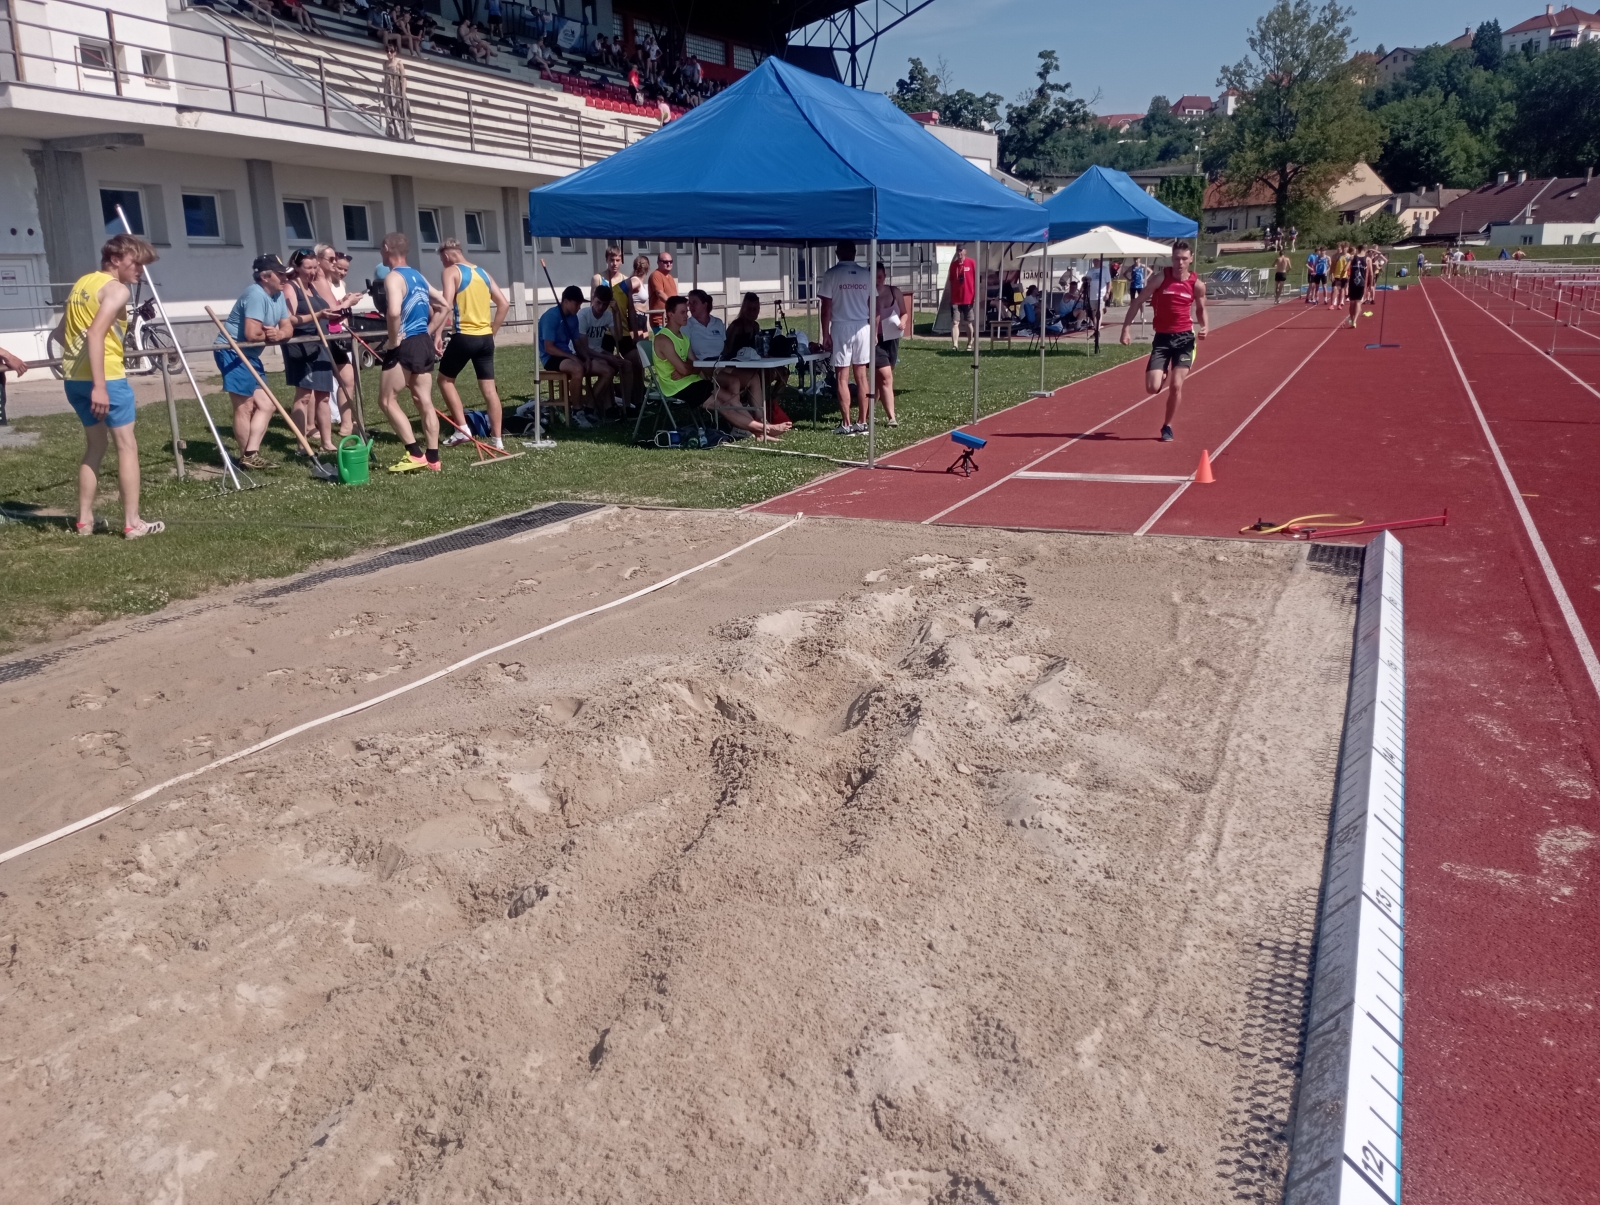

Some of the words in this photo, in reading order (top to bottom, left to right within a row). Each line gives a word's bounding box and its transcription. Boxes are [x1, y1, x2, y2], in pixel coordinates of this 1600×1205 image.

[1375, 889, 1392, 913] 13
[1313, 1014, 1341, 1038] 7
[1361, 1145, 1384, 1183] 12
